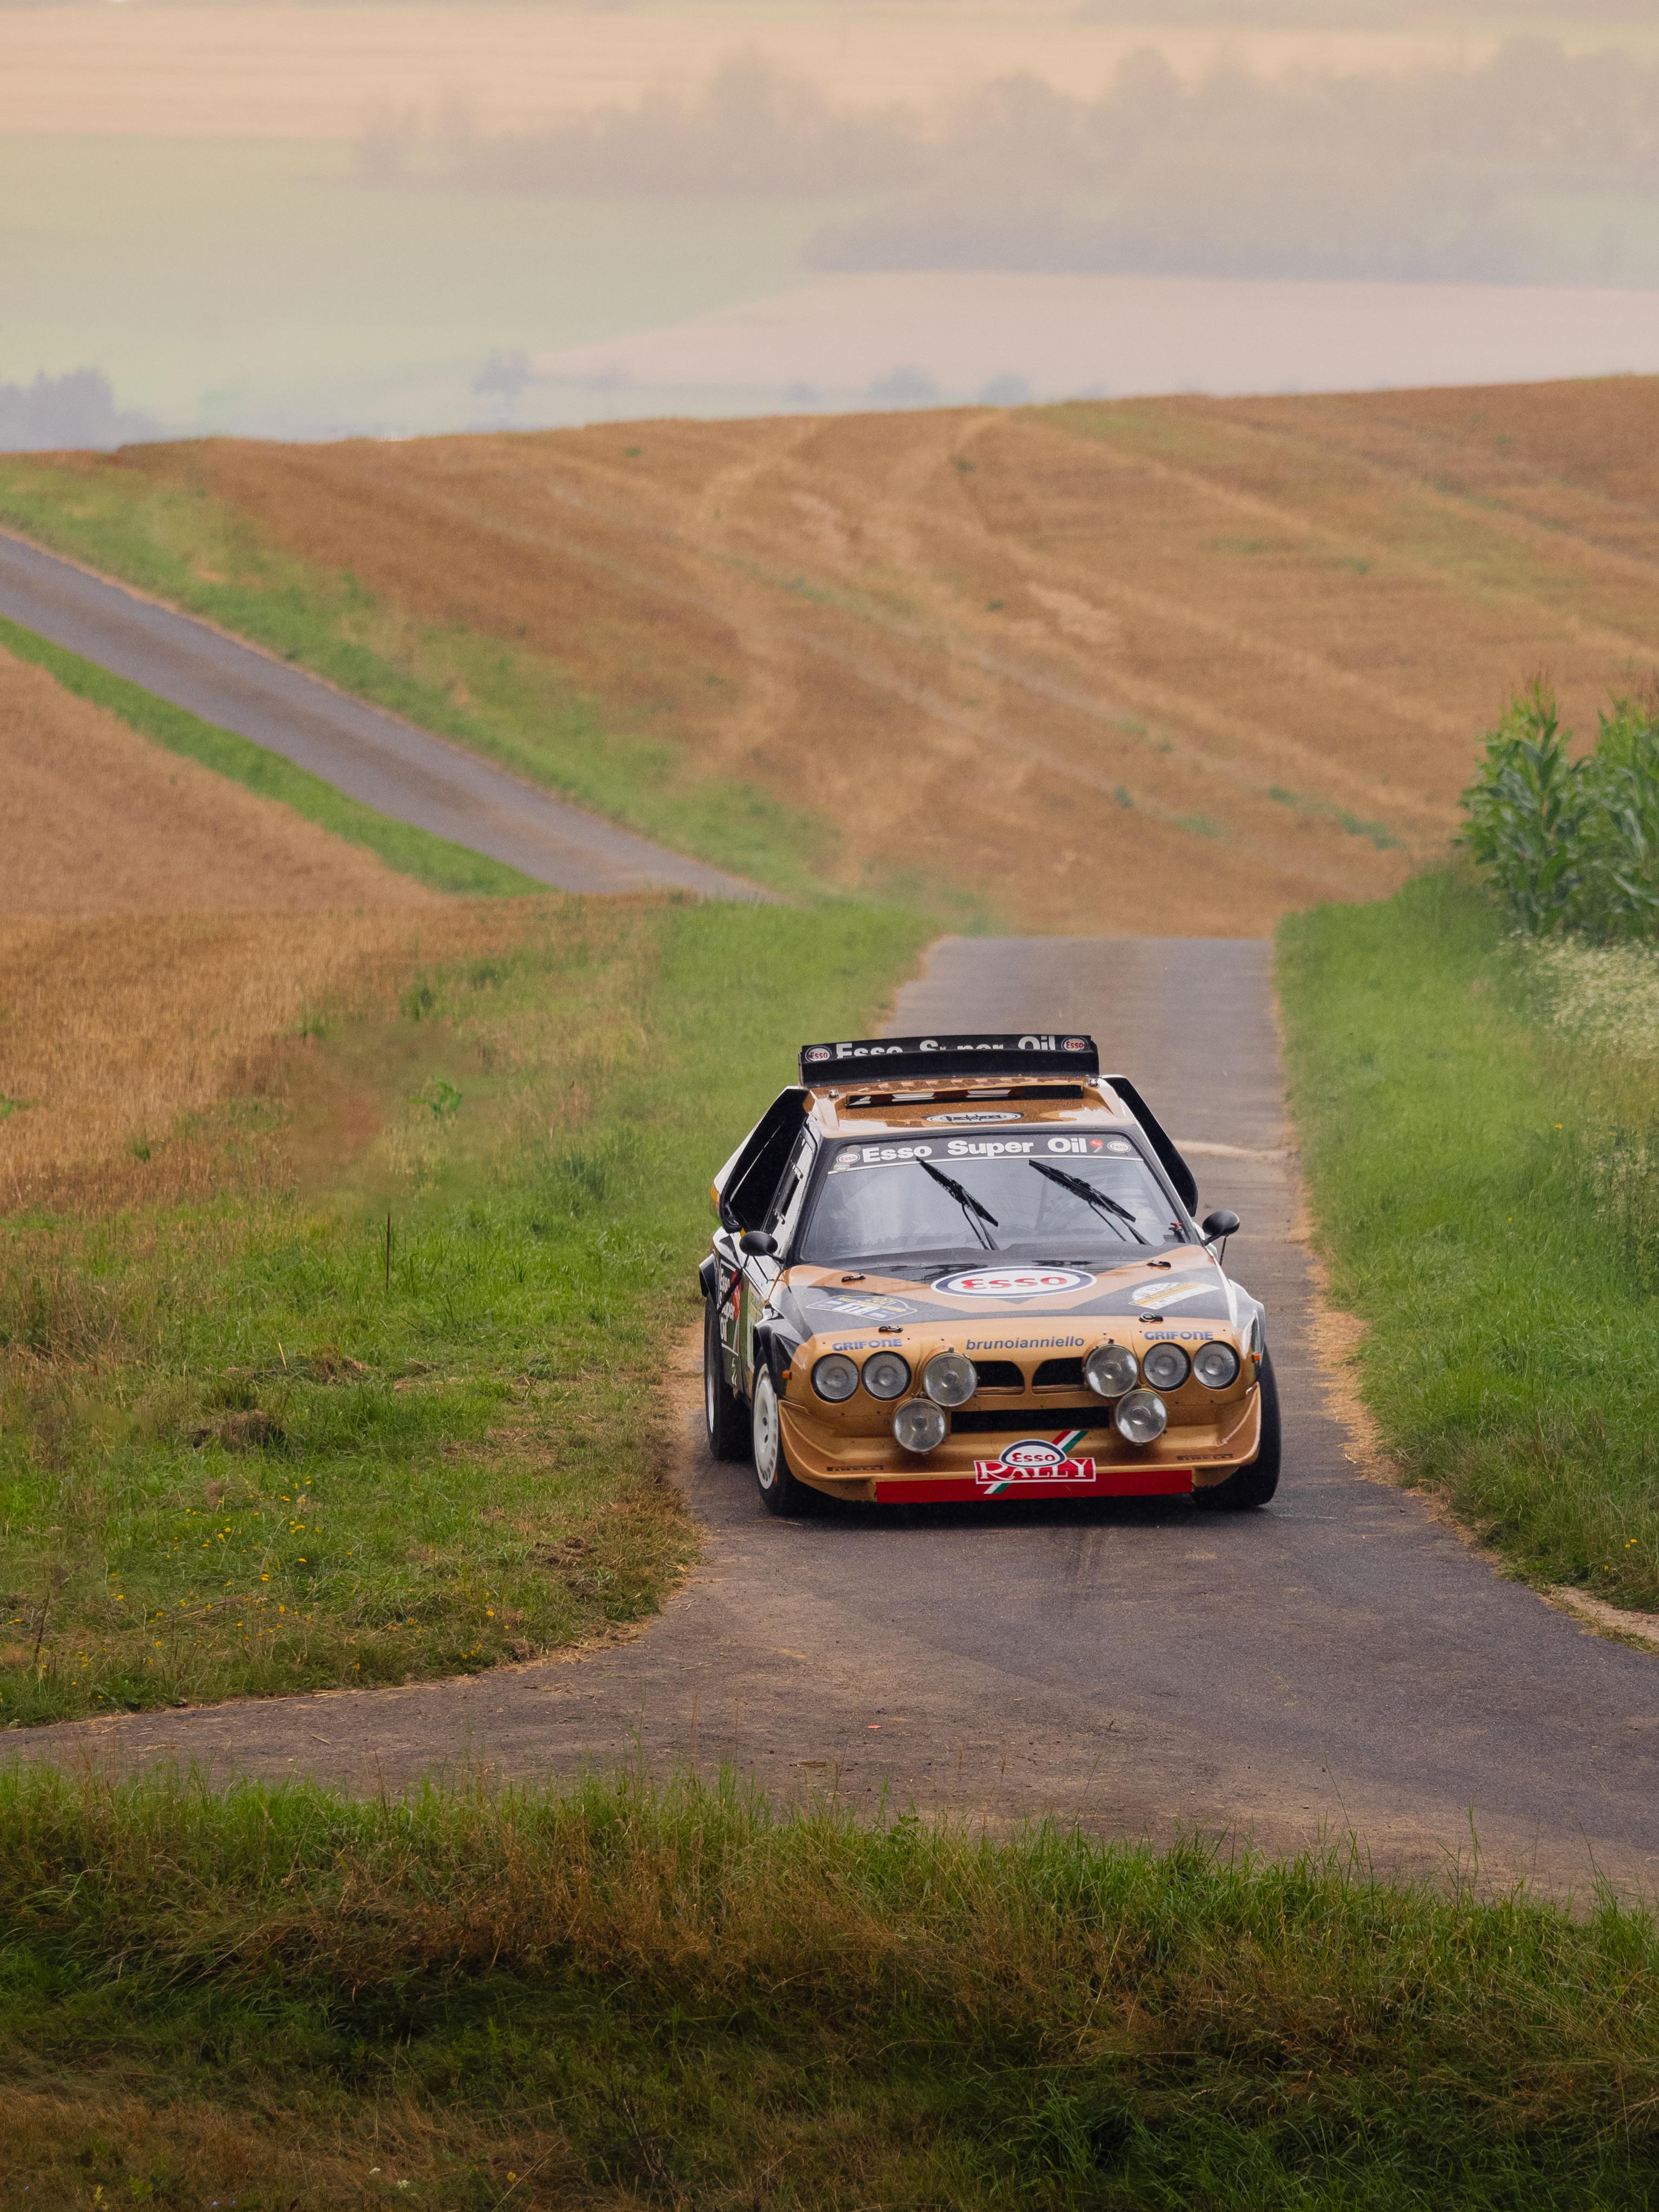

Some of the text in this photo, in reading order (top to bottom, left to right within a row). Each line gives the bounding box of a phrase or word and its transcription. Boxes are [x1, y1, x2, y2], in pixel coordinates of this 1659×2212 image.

[1018, 1035, 1056, 1051] Oil
[1066, 1041, 1083, 1049] Esso
[809, 1052, 828, 1060] Esso
[862, 1138, 1087, 1163] Esso Super Oil
[961, 1276, 1068, 1290] Esso
[1144, 1331, 1214, 1341] GRIFONE
[832, 1338, 903, 1352] GRIFONE
[966, 1336, 1085, 1351] brunoianniello
[1012, 1452, 1056, 1462] Esso
[980, 1459, 1089, 1480] RALLY
